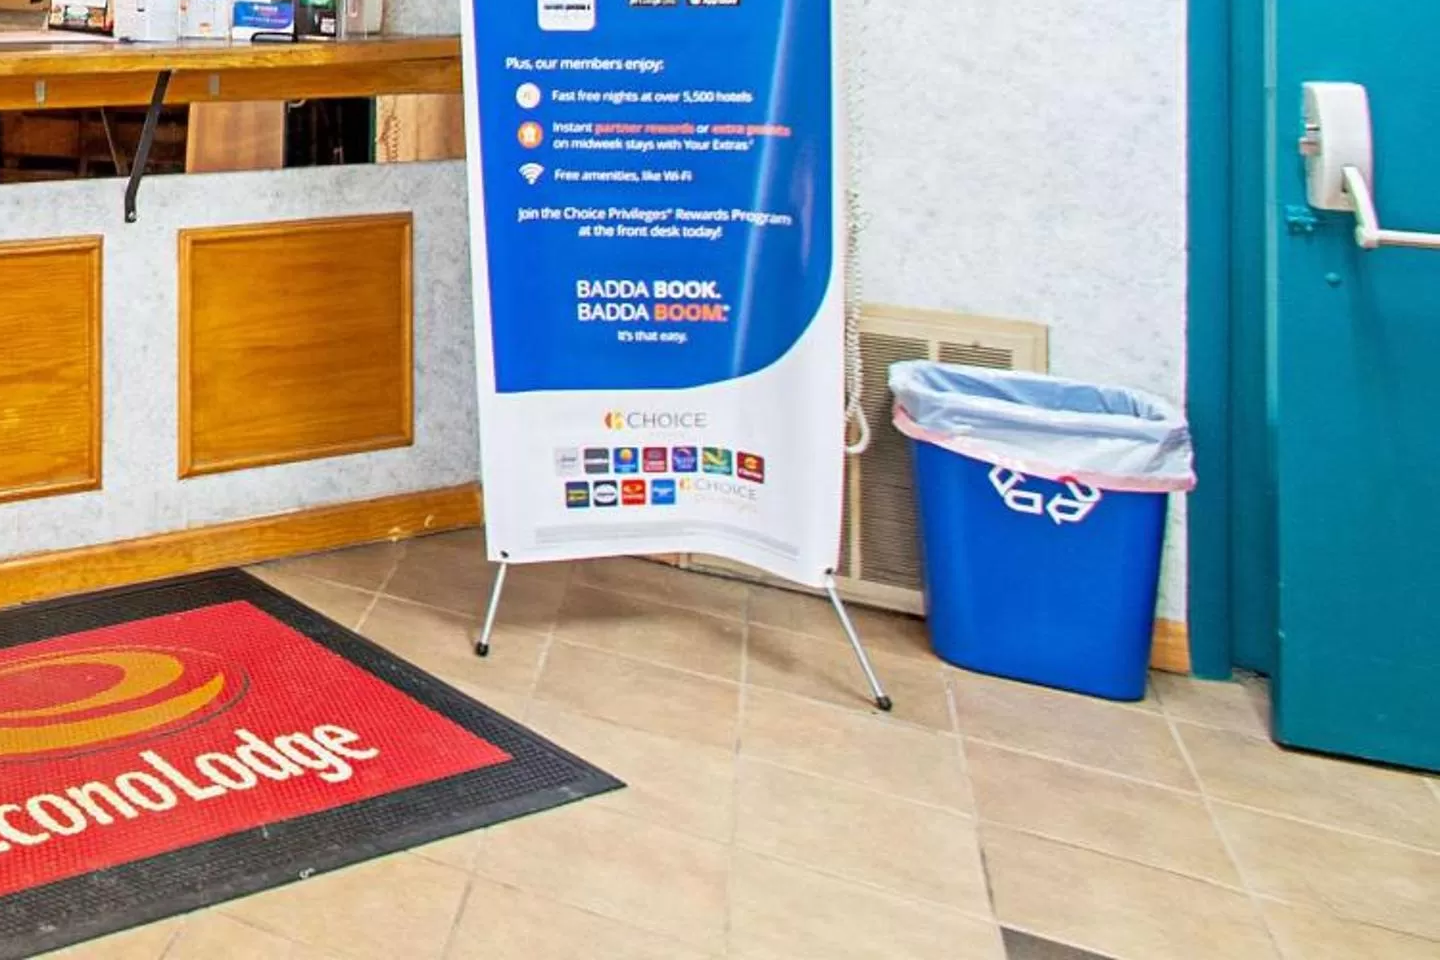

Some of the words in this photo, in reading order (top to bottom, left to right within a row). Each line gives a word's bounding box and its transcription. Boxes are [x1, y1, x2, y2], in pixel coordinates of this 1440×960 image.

[535, 58, 558, 70] our
[559, 56, 623, 71] members
[552, 89, 576, 103] Fast
[577, 89, 601, 102] free
[603, 89, 638, 105] nights
[640, 90, 653, 102] at
[654, 91, 680, 102] over
[715, 90, 753, 103] hotels
[552, 121, 593, 134] Instant
[696, 124, 710, 134] or
[552, 139, 569, 150] on
[570, 138, 623, 151] midweek
[553, 169, 580, 182] Free
[541, 207, 562, 220] the
[563, 206, 606, 221] Choice
[675, 208, 729, 222] Rewards
[730, 209, 792, 227] Program
[578, 225, 592, 238] at
[593, 224, 615, 238] the
[616, 224, 648, 238] front
[650, 225, 681, 239] desk
[575, 279, 650, 299] BADDA
[652, 279, 722, 299] BOOK.
[576, 302, 650, 322] BADDA
[626, 411, 708, 430] CHOICE
